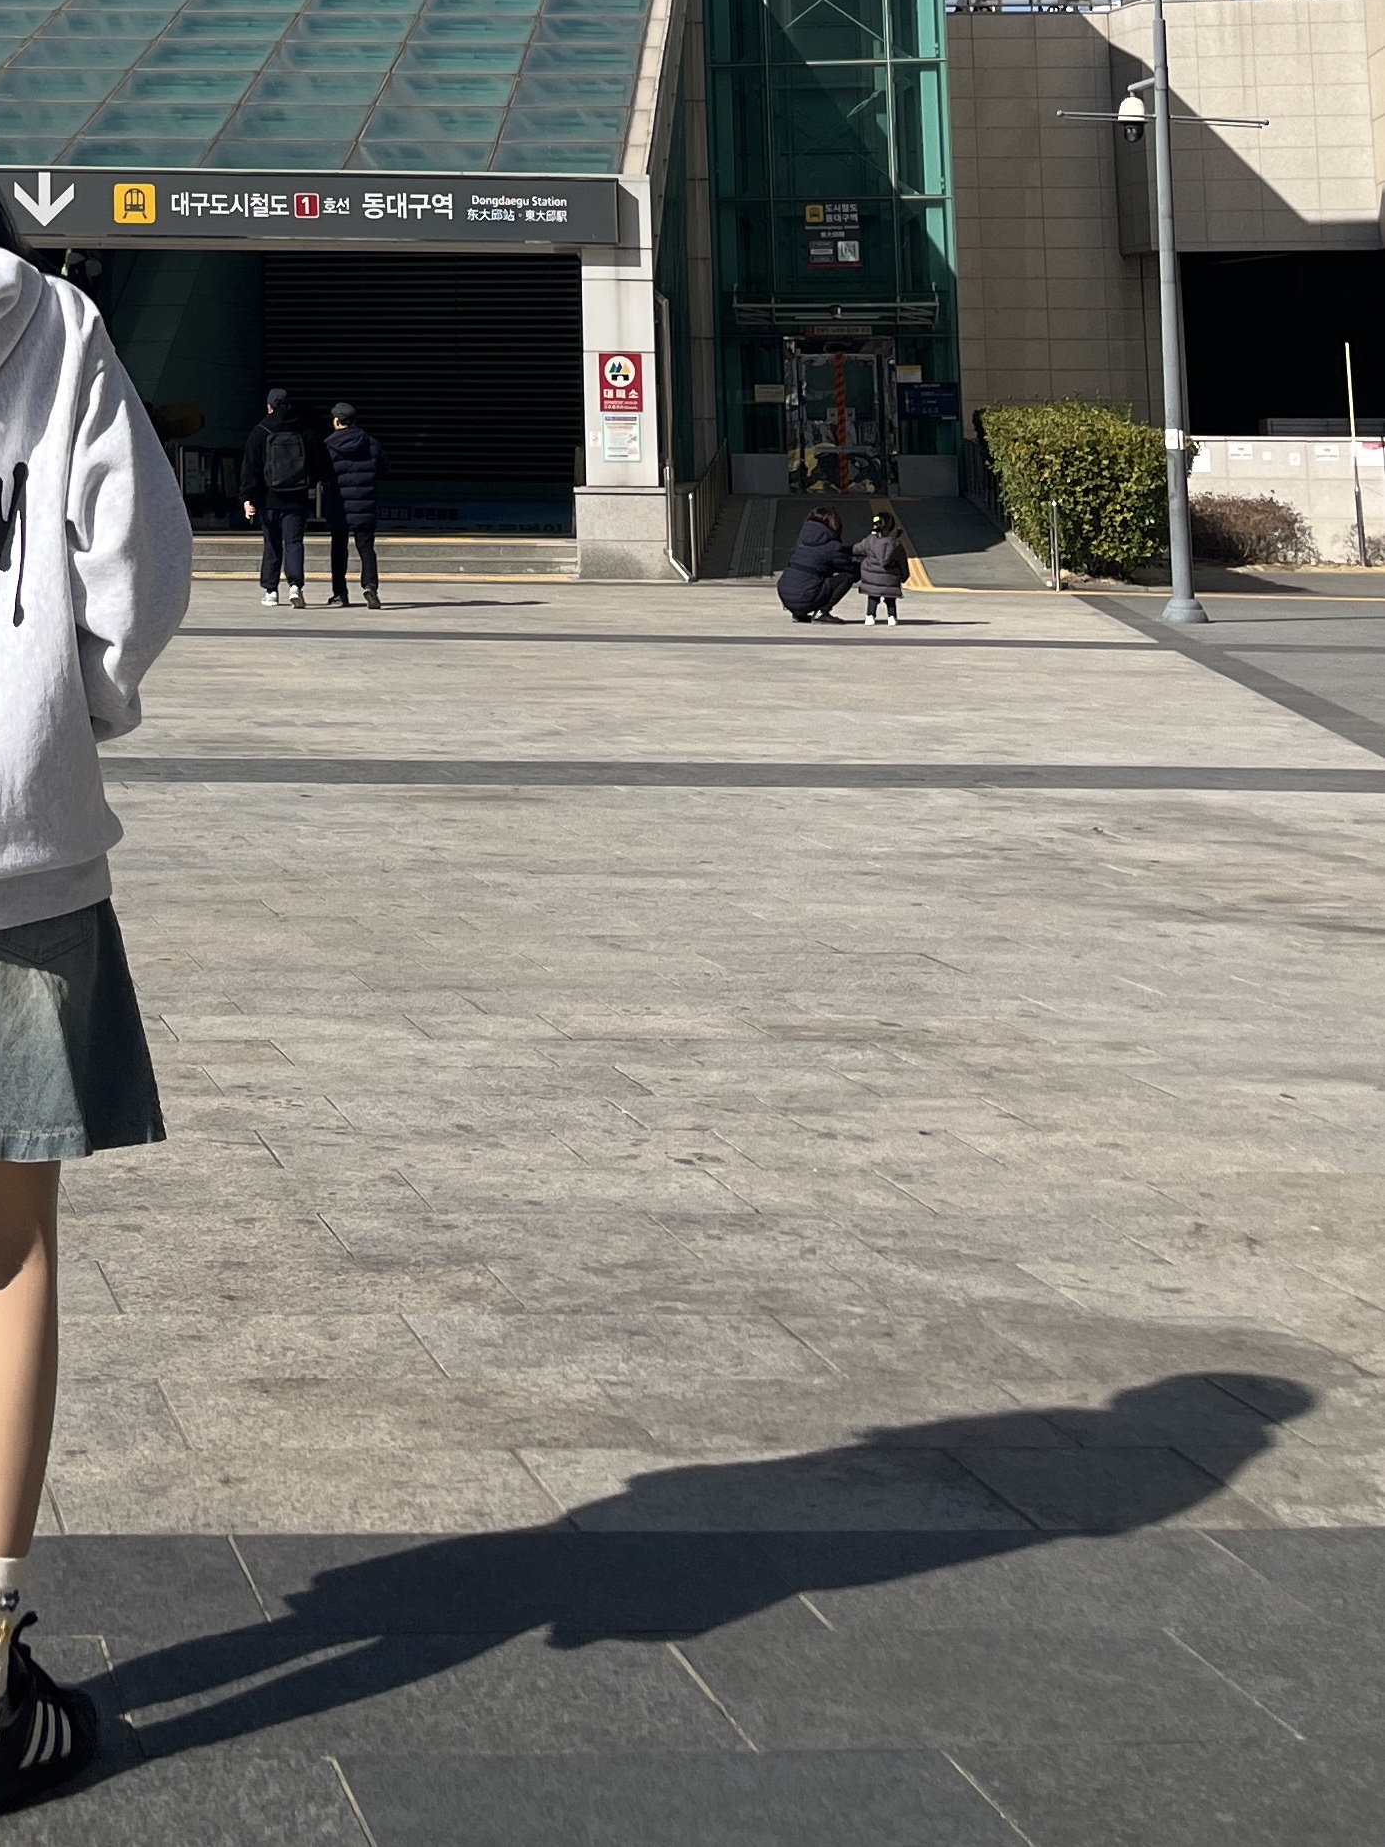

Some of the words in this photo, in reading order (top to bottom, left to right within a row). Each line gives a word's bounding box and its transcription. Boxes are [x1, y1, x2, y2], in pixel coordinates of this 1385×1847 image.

[171, 191, 290, 218] 대구도시철도
[362, 192, 453, 220] 동대구역
[471, 194, 529, 209] Dongdaegu
[531, 195, 568, 207] Station
[603, 388, 639, 399] 대피소
